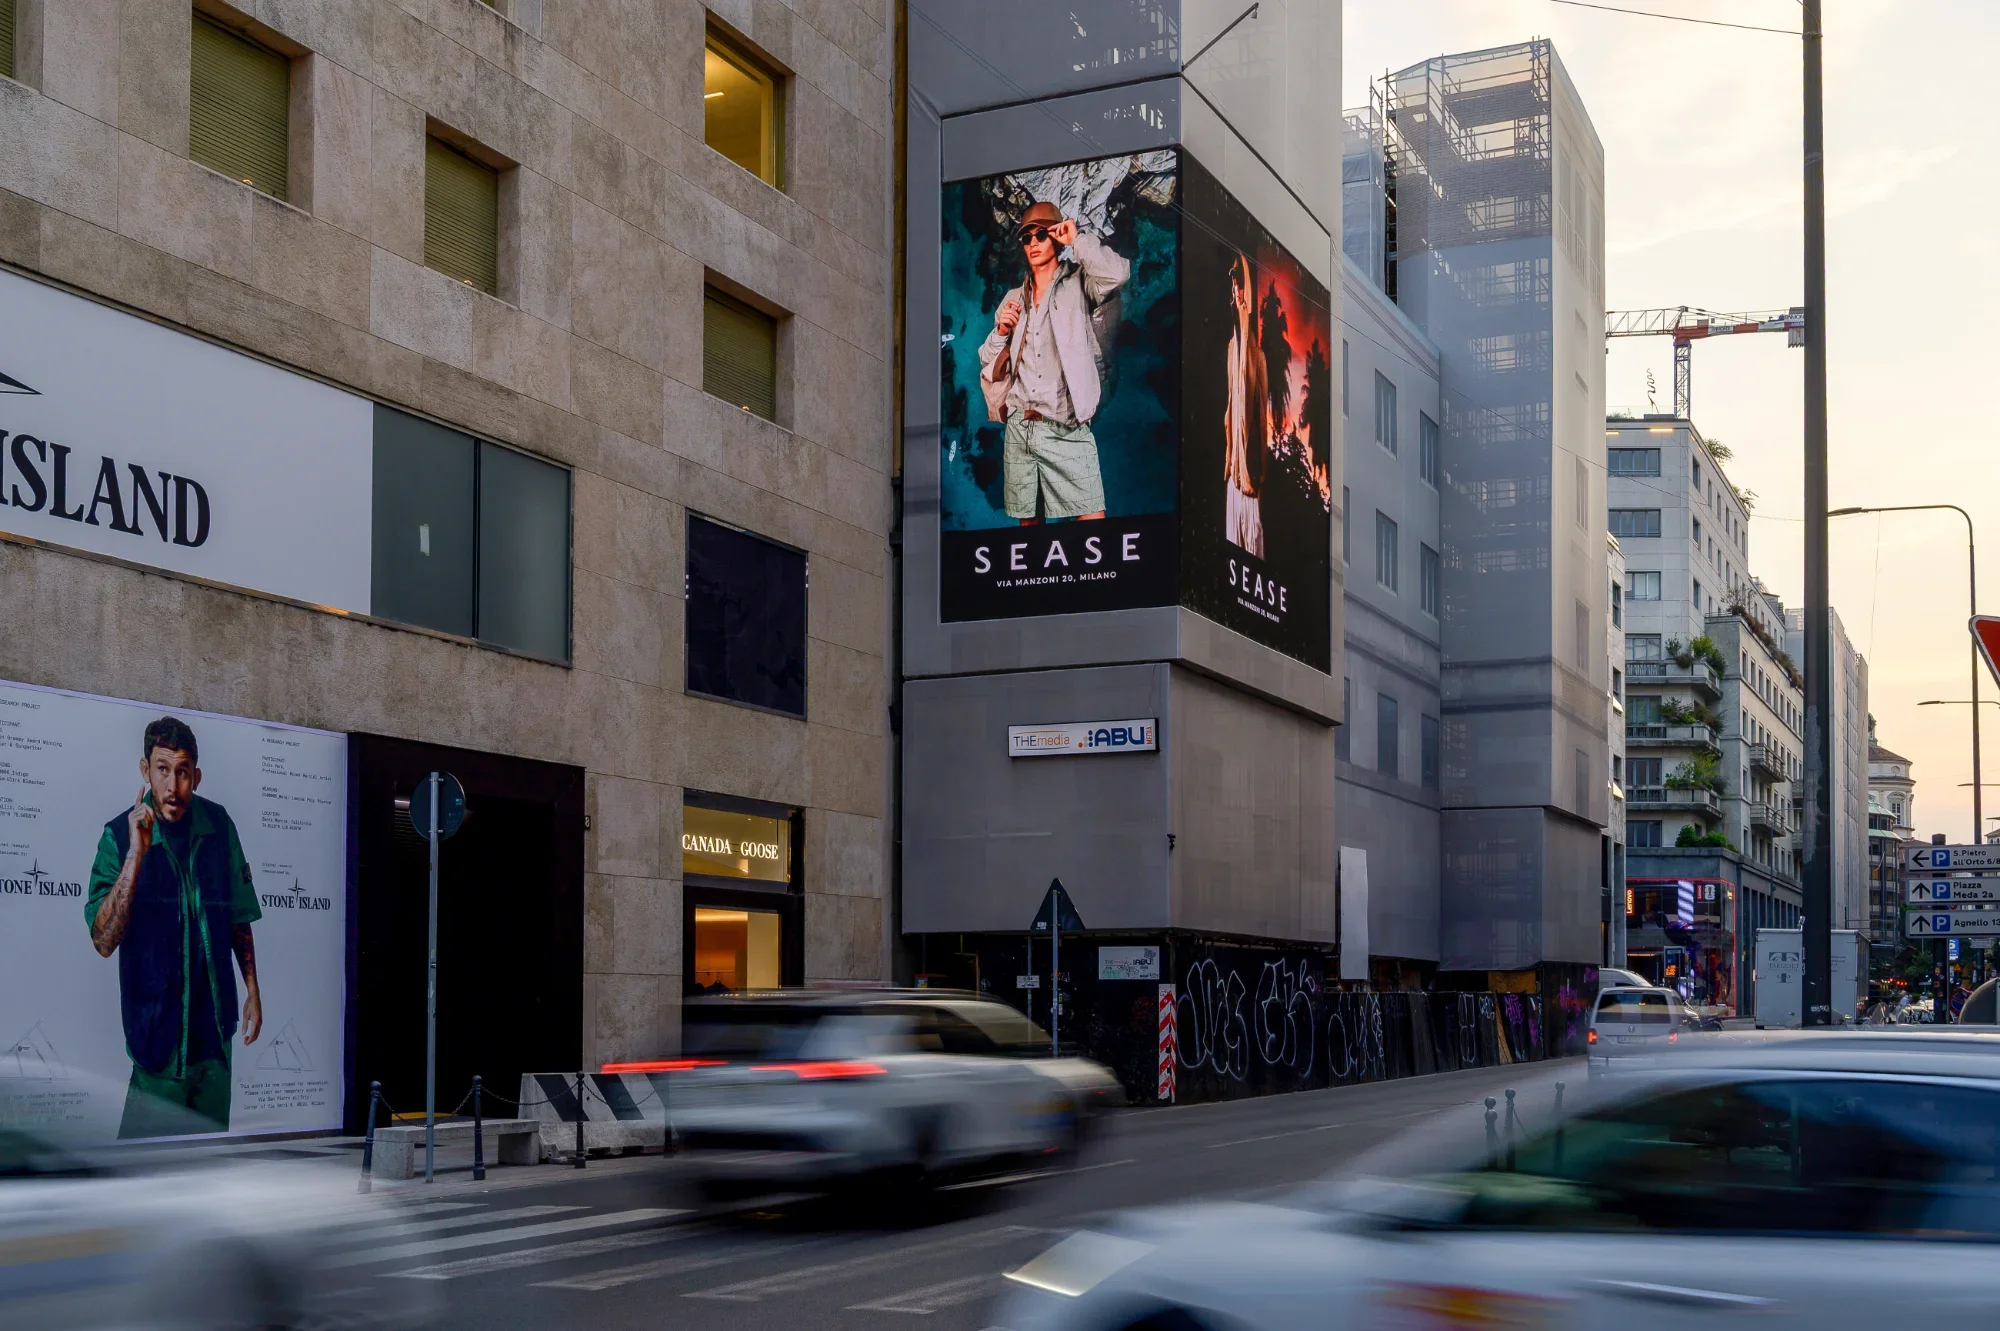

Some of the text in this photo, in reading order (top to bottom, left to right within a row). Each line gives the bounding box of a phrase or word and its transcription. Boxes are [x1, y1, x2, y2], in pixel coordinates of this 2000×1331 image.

[975, 533, 1140, 574] SEASE
[996, 571, 1117, 588] VIA MANZONI 20, MILANO
[1229, 559, 1287, 613] SEASE
[1094, 726, 1145, 746] ABU
[1145, 725, 1153, 745] MEDIA
[682, 834, 779, 860] CANADA GOOSE
[1953, 858, 1985, 866] all'Orto
[39, 881, 82, 897] ISLAND
[1953, 881, 1982, 889] Piazza
[261, 893, 331, 911] STONE ISLAND
[1953, 890, 1994, 899] Meda 2a
[1954, 919, 1989, 928] Agnello
